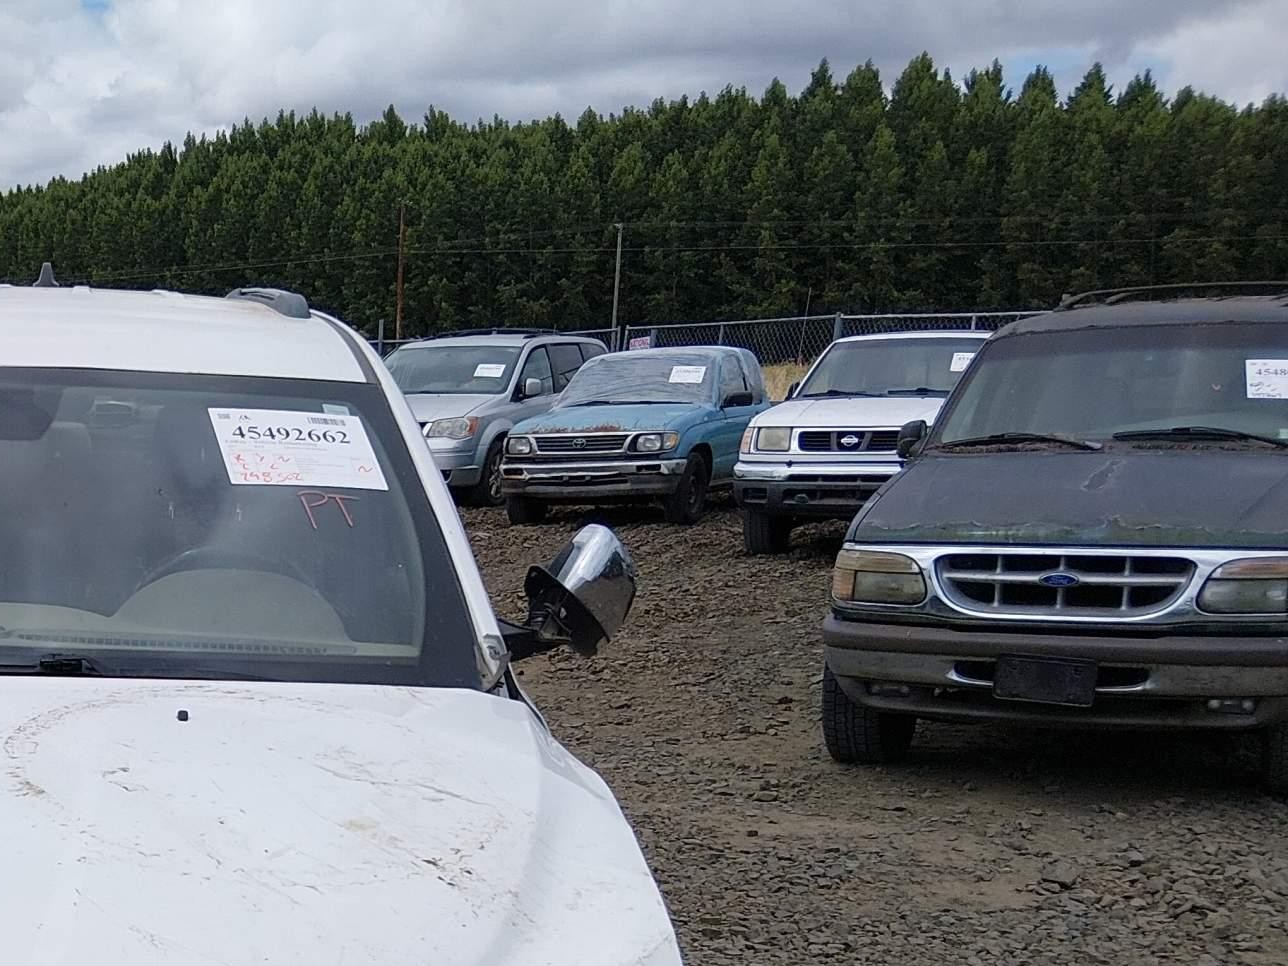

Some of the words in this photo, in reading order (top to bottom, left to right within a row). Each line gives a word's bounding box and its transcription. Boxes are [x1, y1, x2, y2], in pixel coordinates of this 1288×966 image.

[1255, 368, 1288, 376] 4548
[232, 425, 351, 445] 45492662
[296, 489, 360, 530] PT
